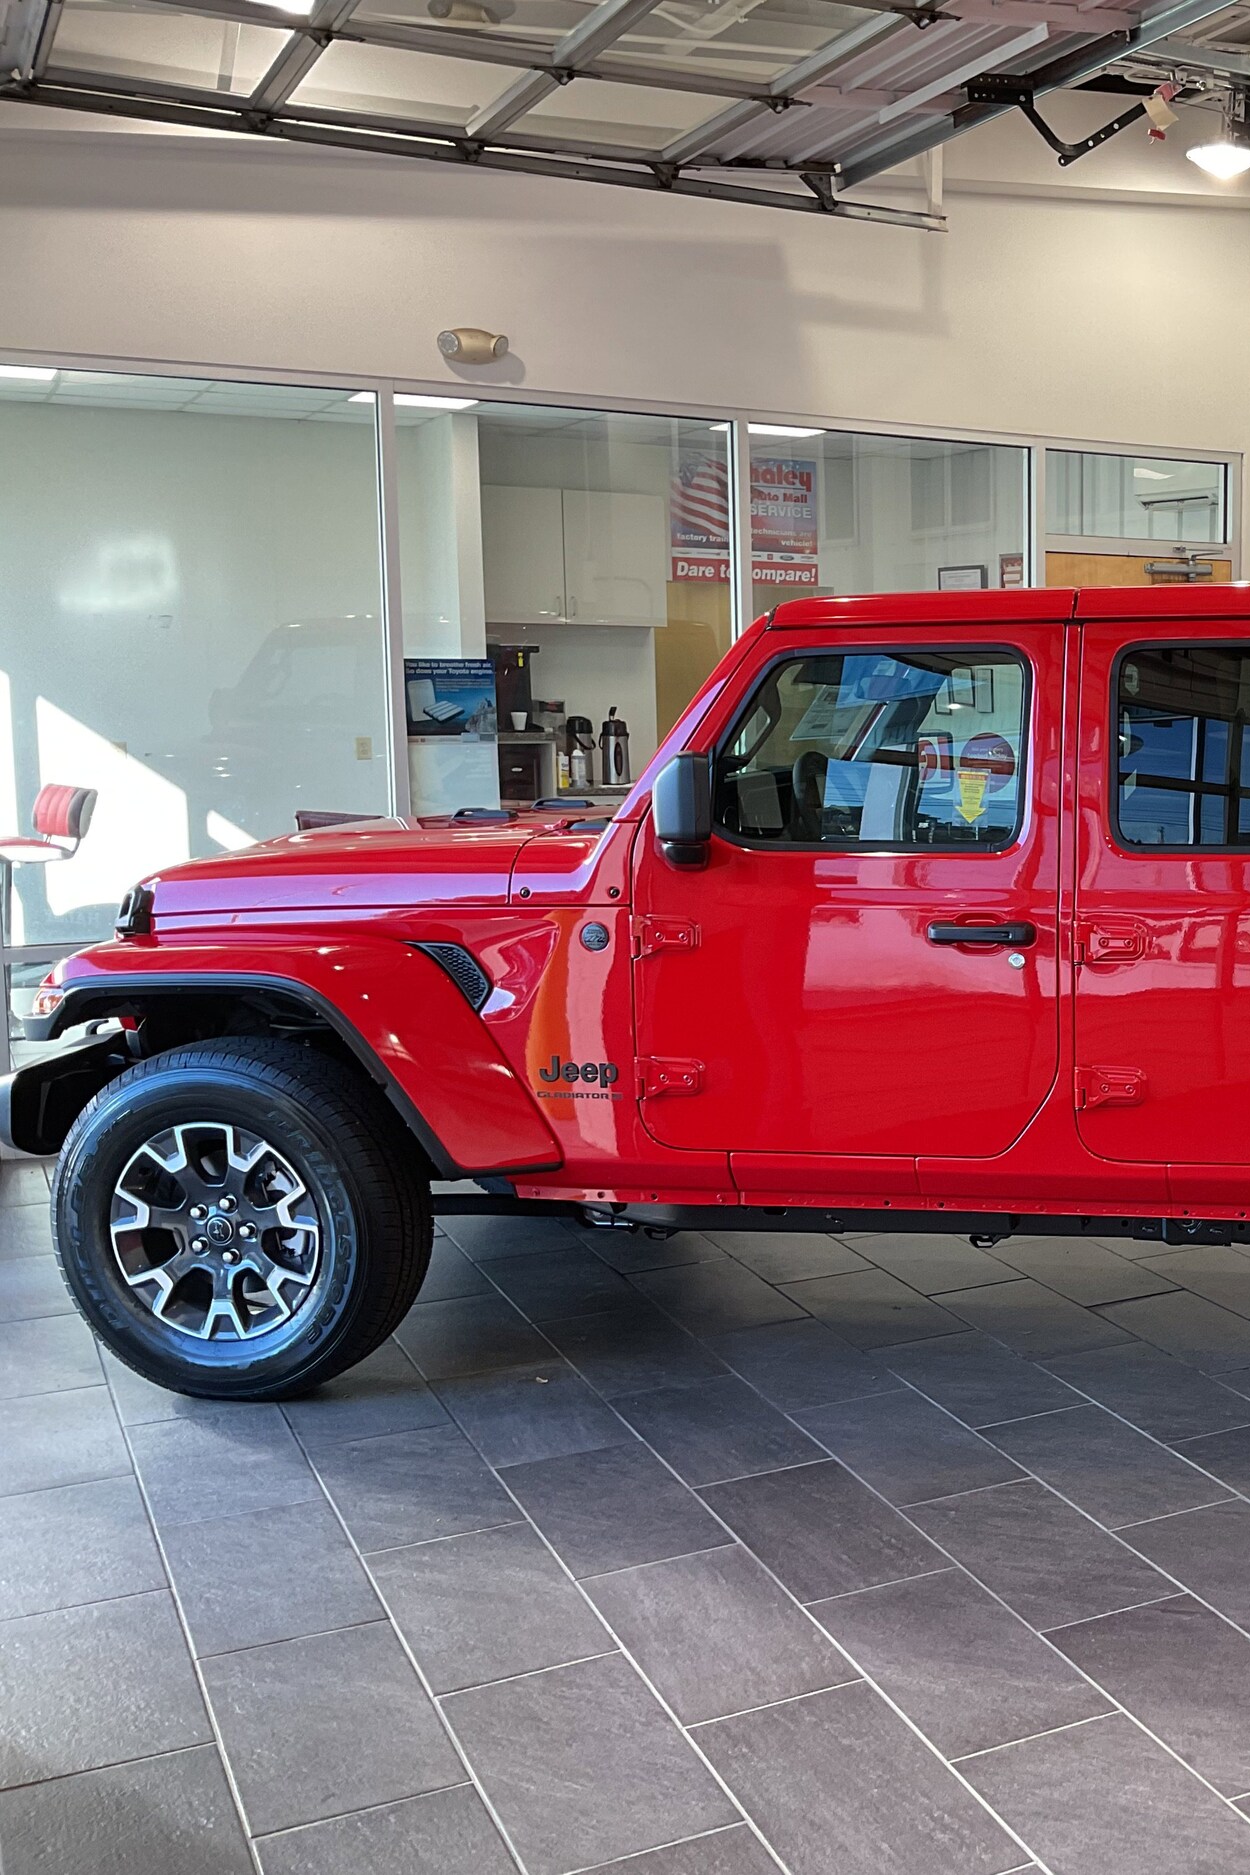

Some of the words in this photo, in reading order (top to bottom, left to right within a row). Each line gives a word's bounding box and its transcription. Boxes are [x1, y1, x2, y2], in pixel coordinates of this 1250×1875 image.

[783, 493, 807, 503] Mall
[750, 504, 812, 518] SERVICE
[676, 533, 708, 542] factory
[709, 535, 729, 543] train
[677, 561, 715, 578] Dare
[752, 568, 816, 583] ompare!
[448, 667, 469, 675] Toyota
[539, 1055, 618, 1088] Jeep
[536, 1091, 609, 1100] GLADIATOR
[264, 1109, 352, 1345] BRIDGESTONE
